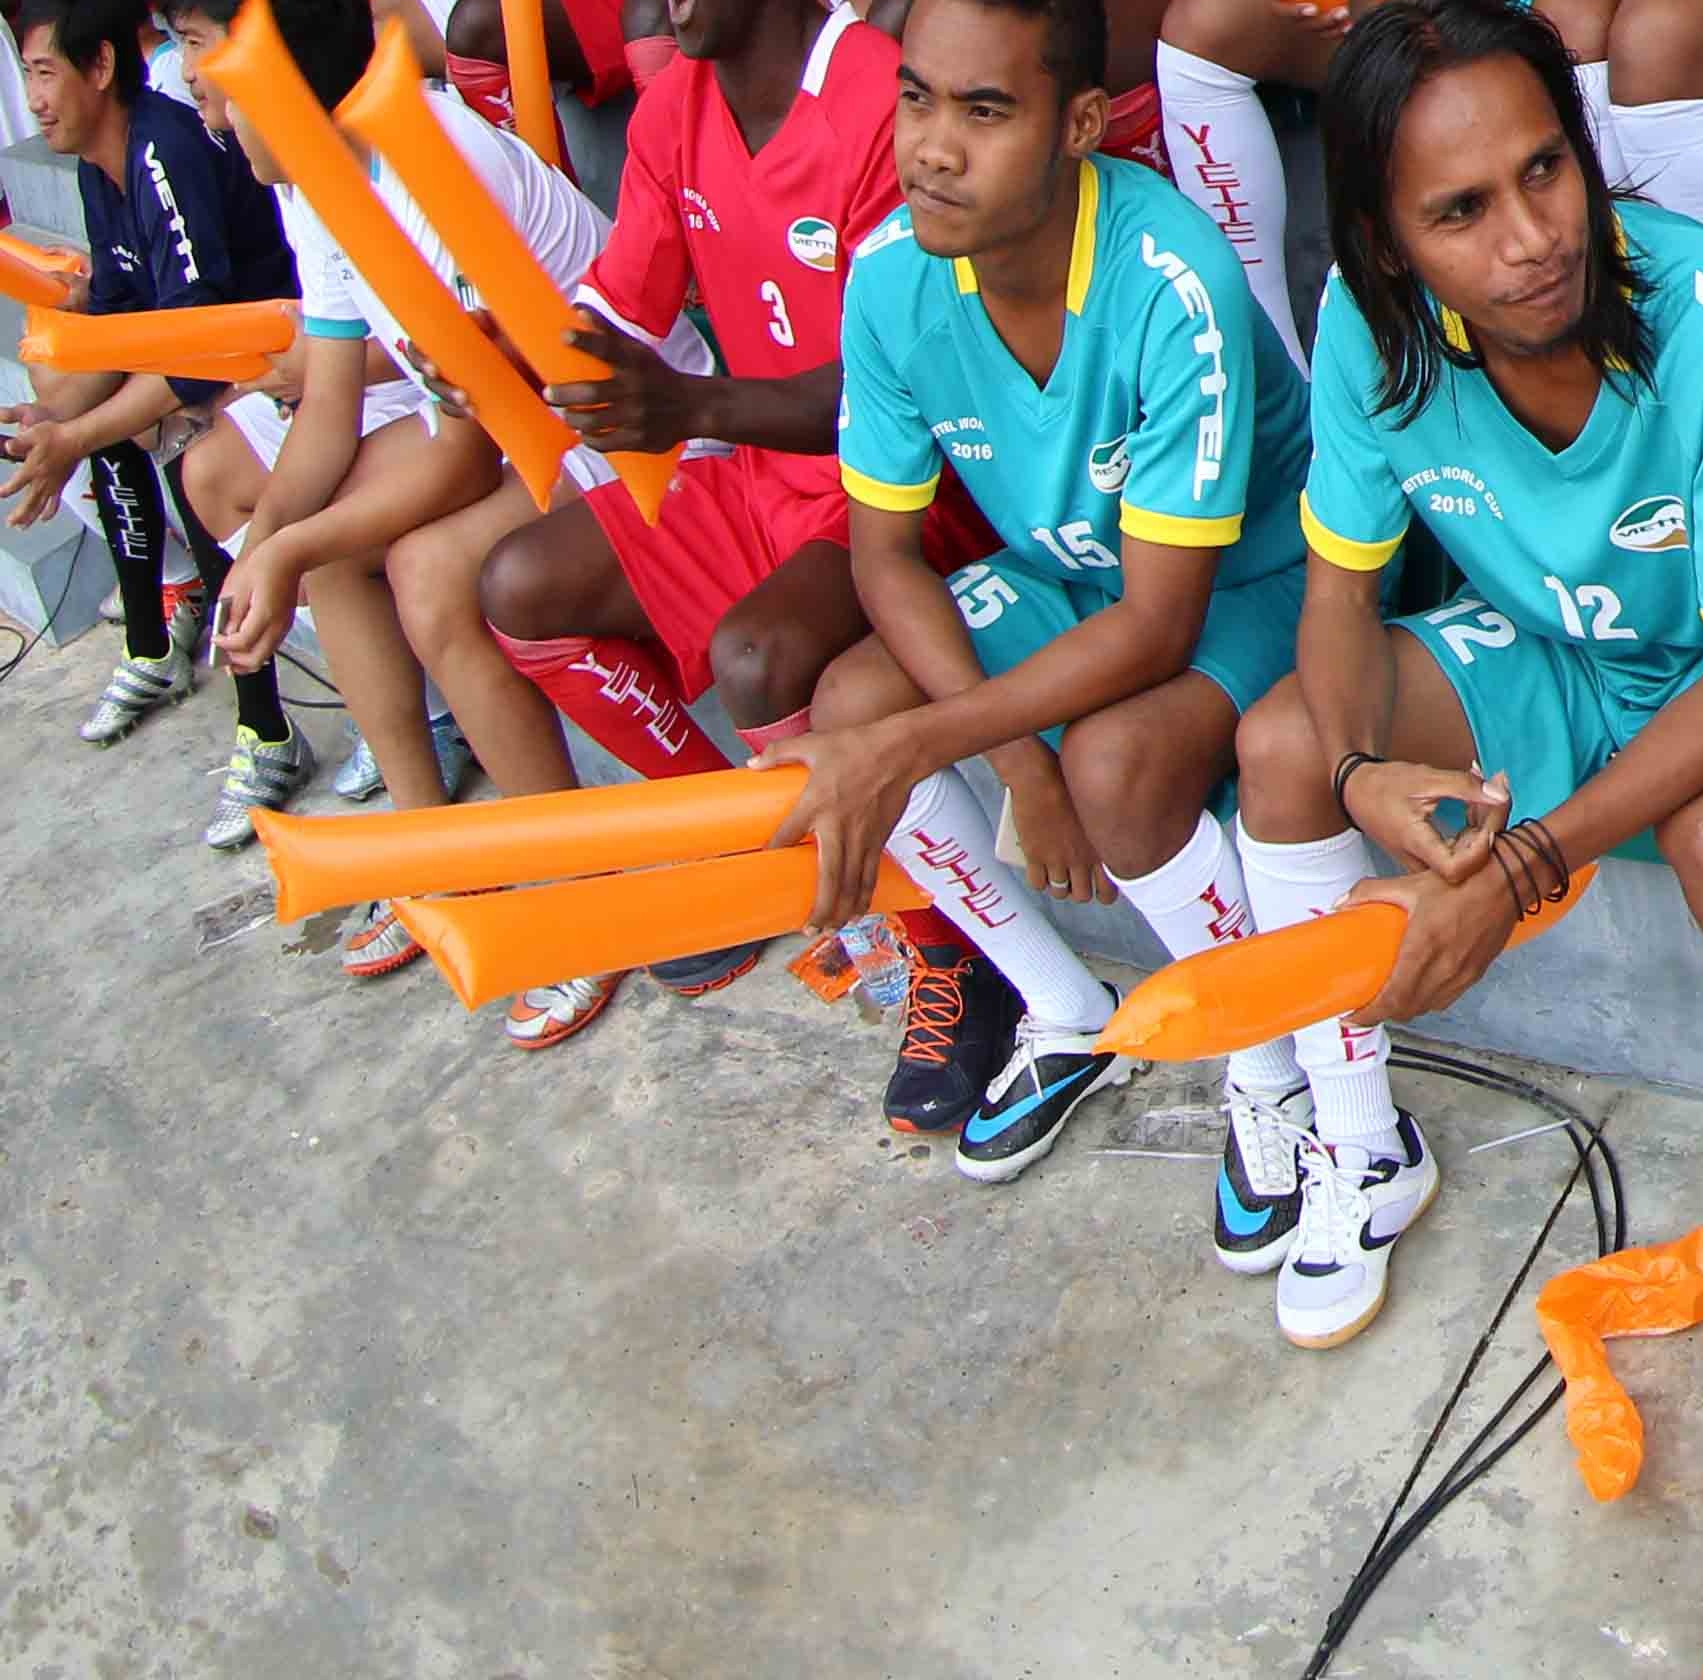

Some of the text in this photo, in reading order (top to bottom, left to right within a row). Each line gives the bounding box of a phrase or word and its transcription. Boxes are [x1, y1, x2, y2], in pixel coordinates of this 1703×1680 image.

[145, 141, 199, 281] VIETTE
[761, 279, 797, 348] 3
[1141, 231, 1229, 502] VIETTEL
[951, 441, 994, 462] 2016
[1430, 491, 1478, 517] 2016
[1440, 466, 1486, 493] WORLD
[1483, 490, 1504, 521] CUP
[1616, 516, 1684, 537] VIETT
[1030, 519, 1120, 571] 15
[949, 562, 1020, 631] 15
[1542, 575, 1639, 641] 12
[1420, 597, 1518, 666] 12
